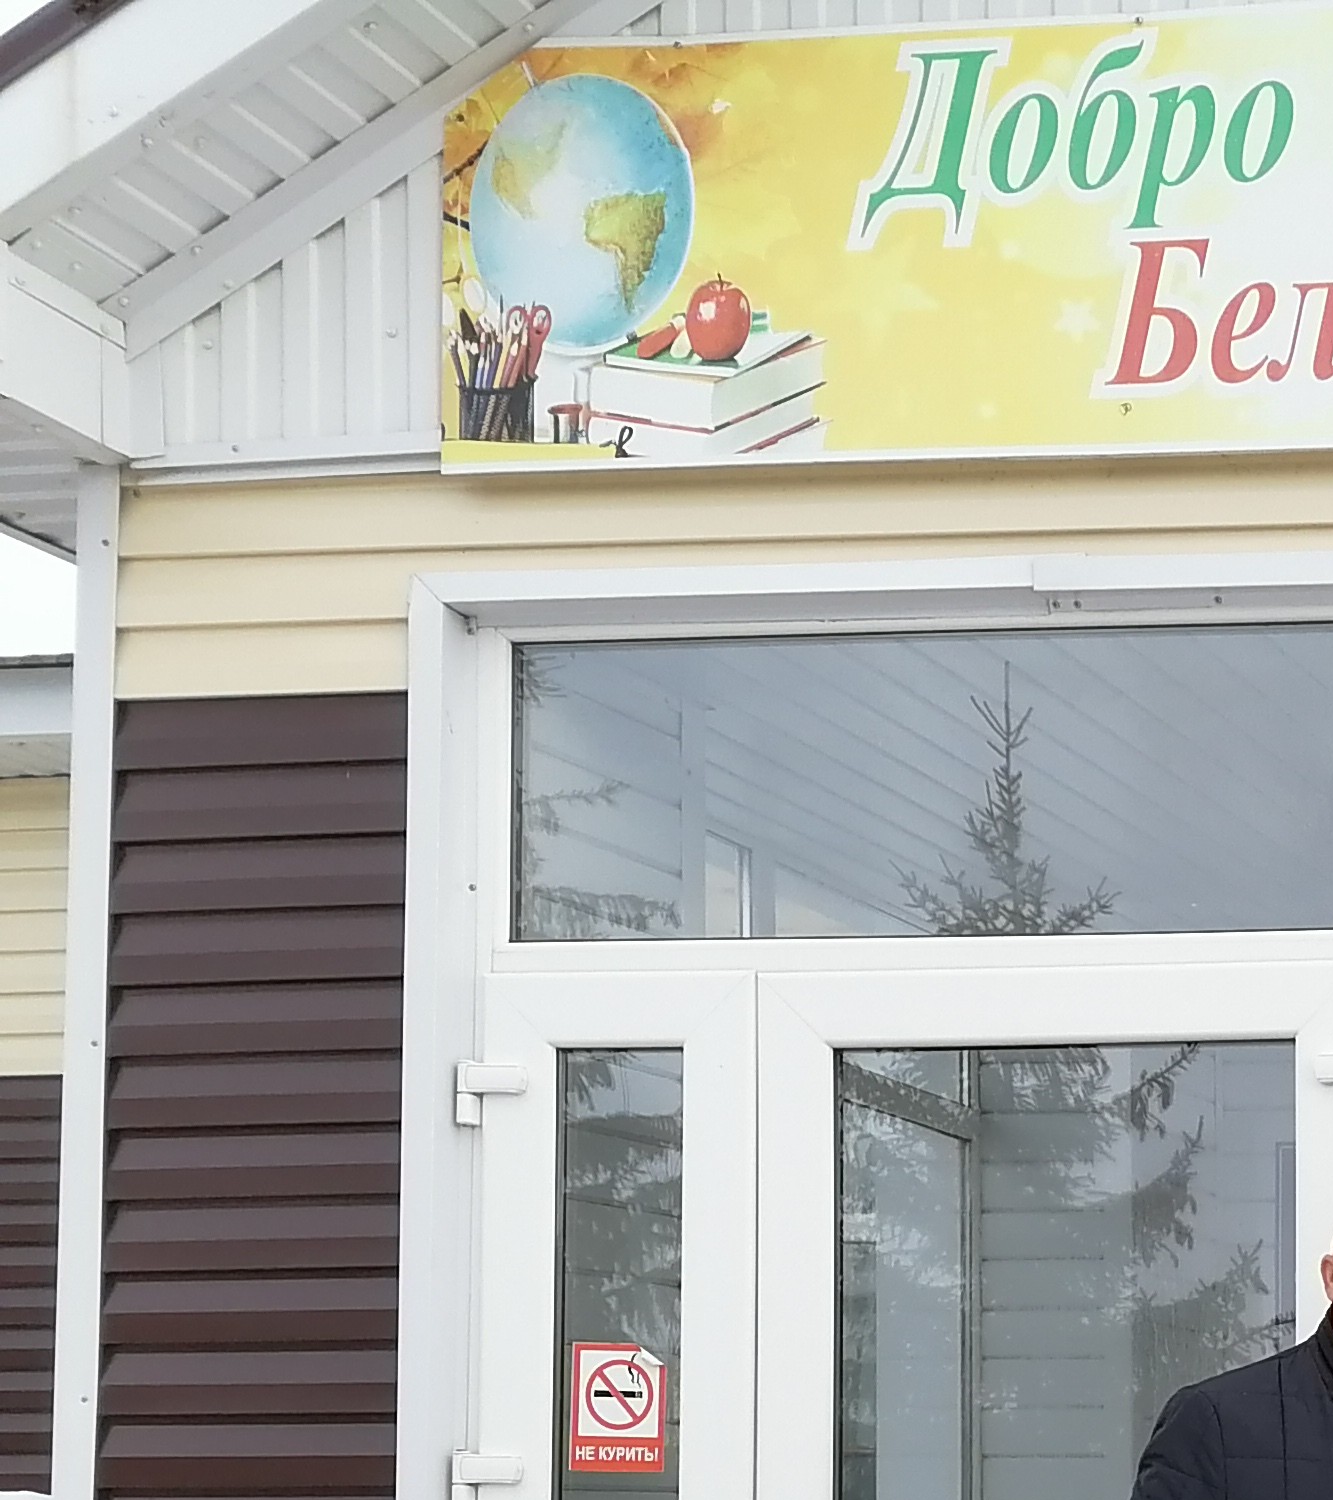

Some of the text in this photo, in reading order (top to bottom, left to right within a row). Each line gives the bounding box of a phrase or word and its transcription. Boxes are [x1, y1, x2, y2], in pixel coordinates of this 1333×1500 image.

[861, 39, 1295, 238] Добро
[575, 1445, 659, 1462] НЕ КУРИТЬ!
